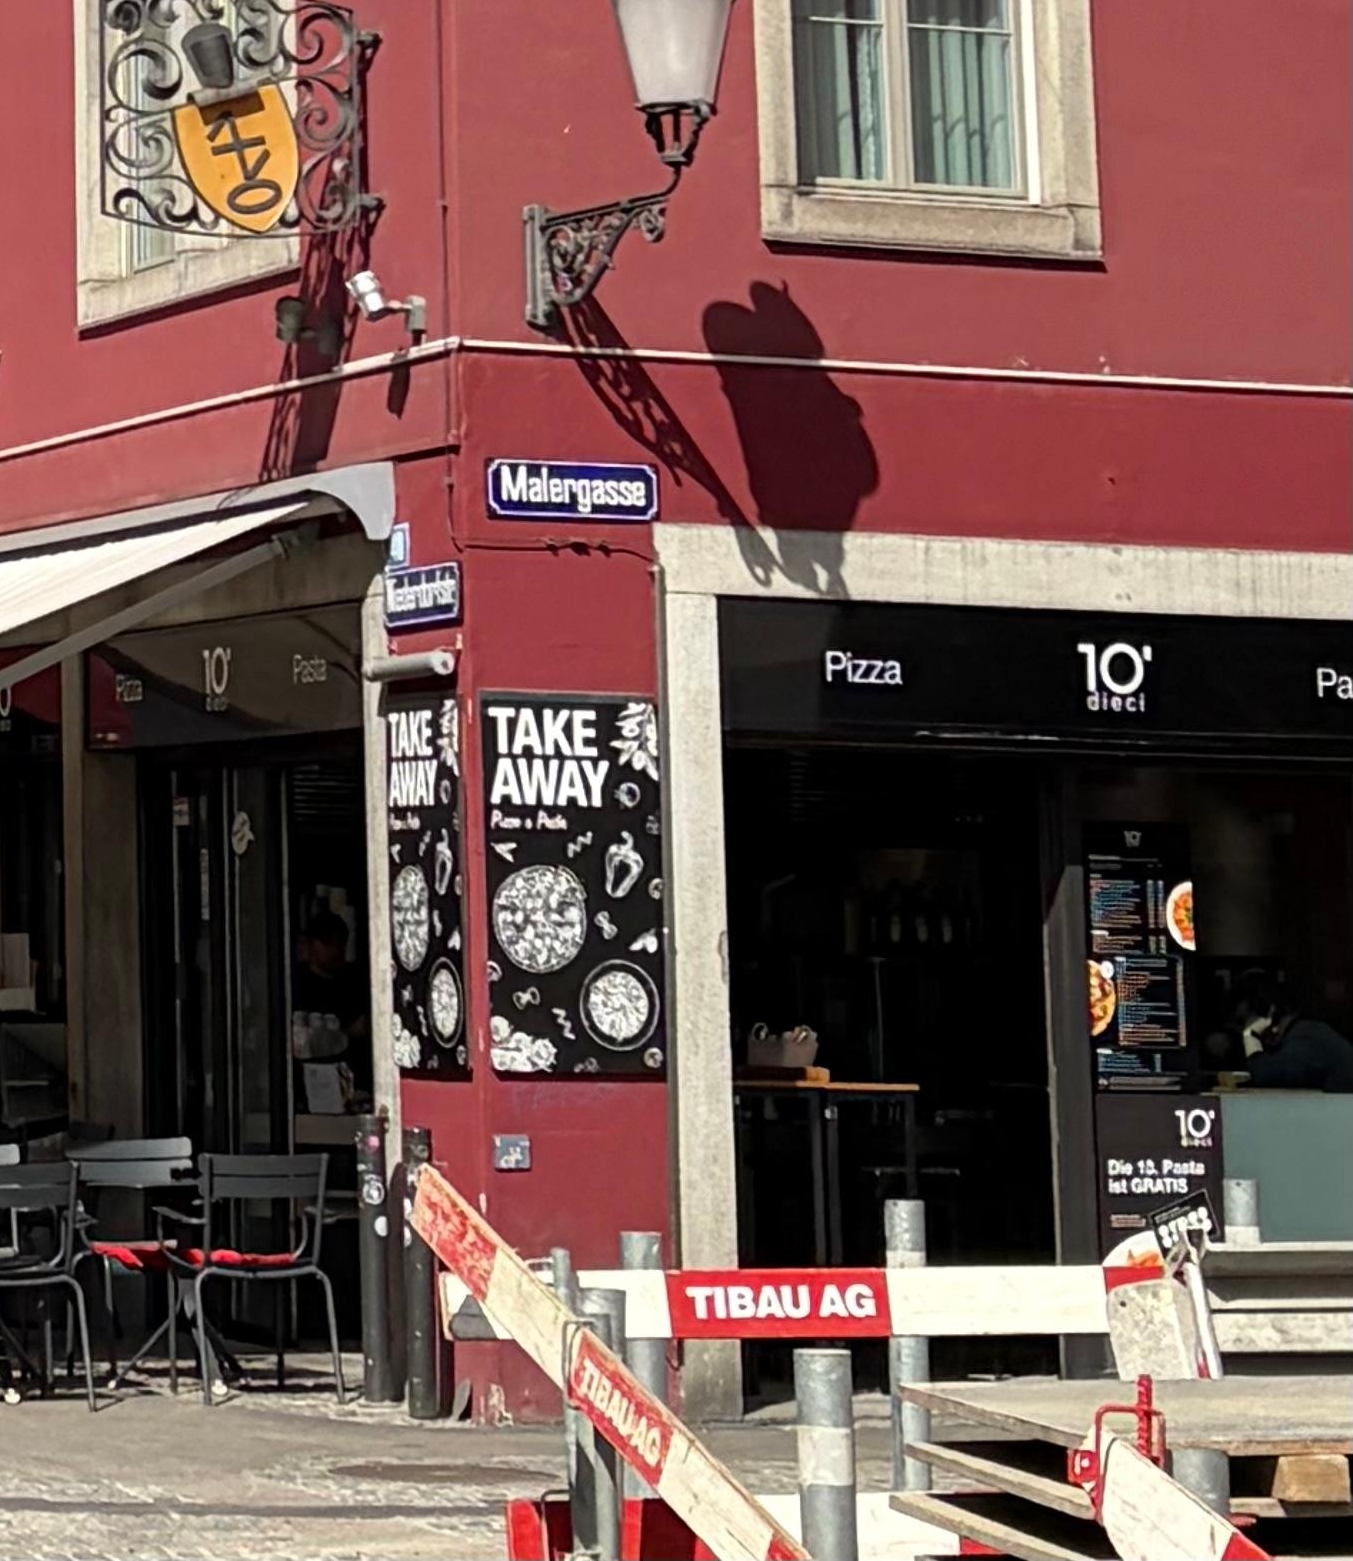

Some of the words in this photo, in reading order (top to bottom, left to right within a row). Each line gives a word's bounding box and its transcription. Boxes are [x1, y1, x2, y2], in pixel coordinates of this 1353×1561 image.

[500, 464, 647, 513] Malergasse
[293, 653, 328, 686] Pasta
[825, 651, 903, 685] Pizza
[1087, 692, 1146, 713] dieci
[388, 710, 433, 757] TAKE
[488, 707, 599, 757] TAKE
[389, 759, 438, 808] AWAY
[490, 757, 610, 808] AWAY
[1107, 1159, 1133, 1176] Die
[1162, 1159, 1206, 1176] Pasta
[1108, 1178, 1129, 1195] ist
[1131, 1177, 1189, 1195] GRATIS
[685, 1286, 810, 1320] TIBAU
[819, 1284, 877, 1318] AG
[581, 1358, 638, 1438] TIBAU
[631, 1414, 662, 1468] AG
